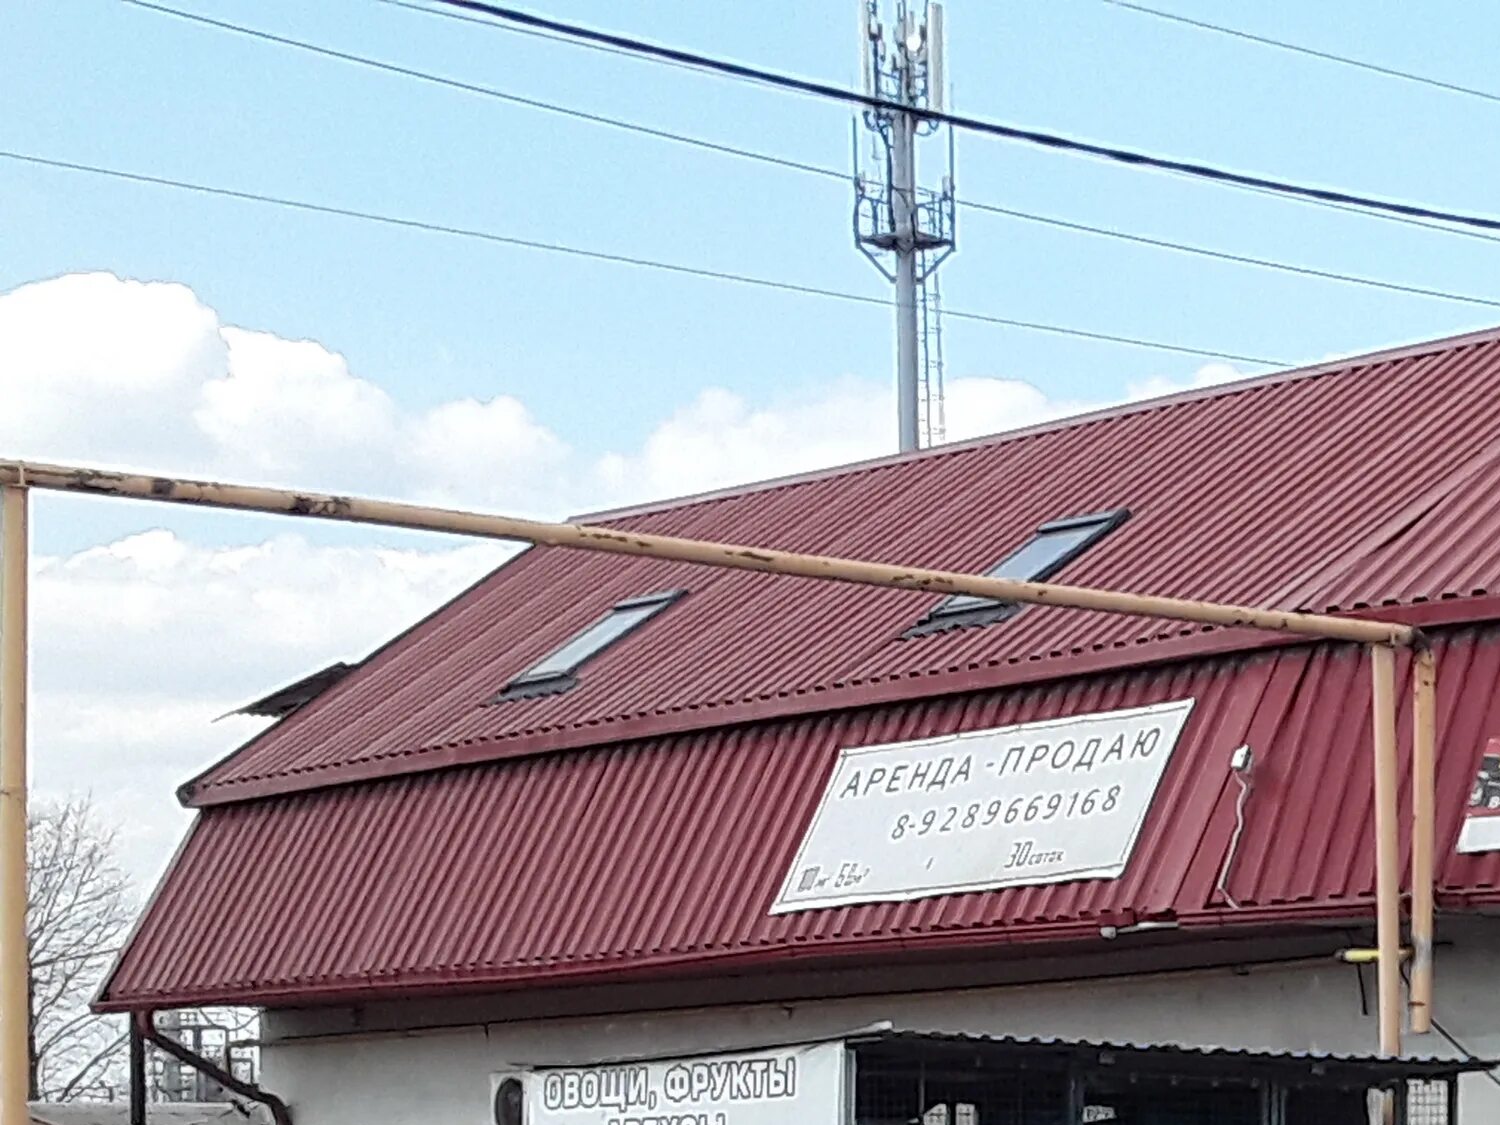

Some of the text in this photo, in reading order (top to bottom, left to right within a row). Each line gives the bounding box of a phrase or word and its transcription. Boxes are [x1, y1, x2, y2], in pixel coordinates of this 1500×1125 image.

[890, 785, 1122, 842] 8-9289669168
[544, 1057, 796, 1112] ОВОЩИ, ФРУКТЫ
